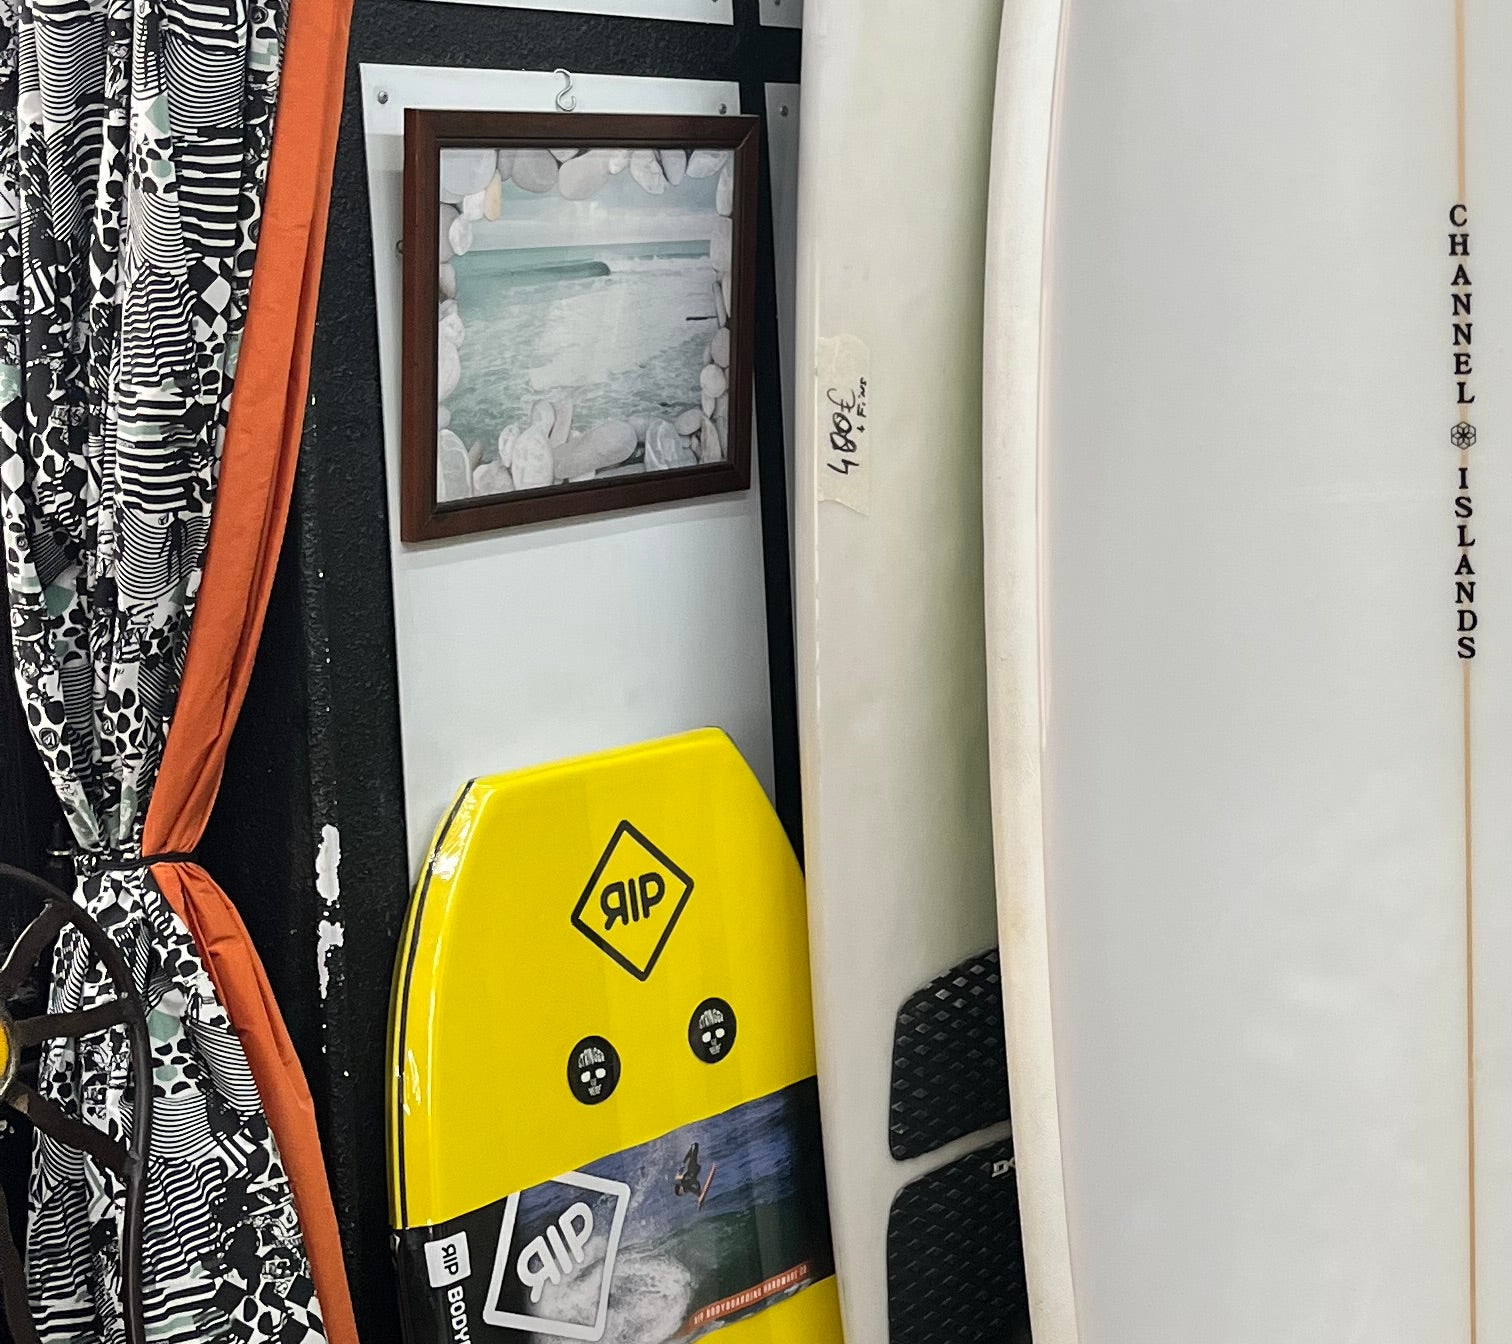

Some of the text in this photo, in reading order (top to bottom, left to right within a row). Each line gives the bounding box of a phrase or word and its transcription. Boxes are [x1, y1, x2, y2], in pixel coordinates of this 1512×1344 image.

[1448, 203, 1477, 405] CHANNEL
[1453, 467, 1478, 660] ISLANDS
[512, 1200, 598, 1305] RIP
